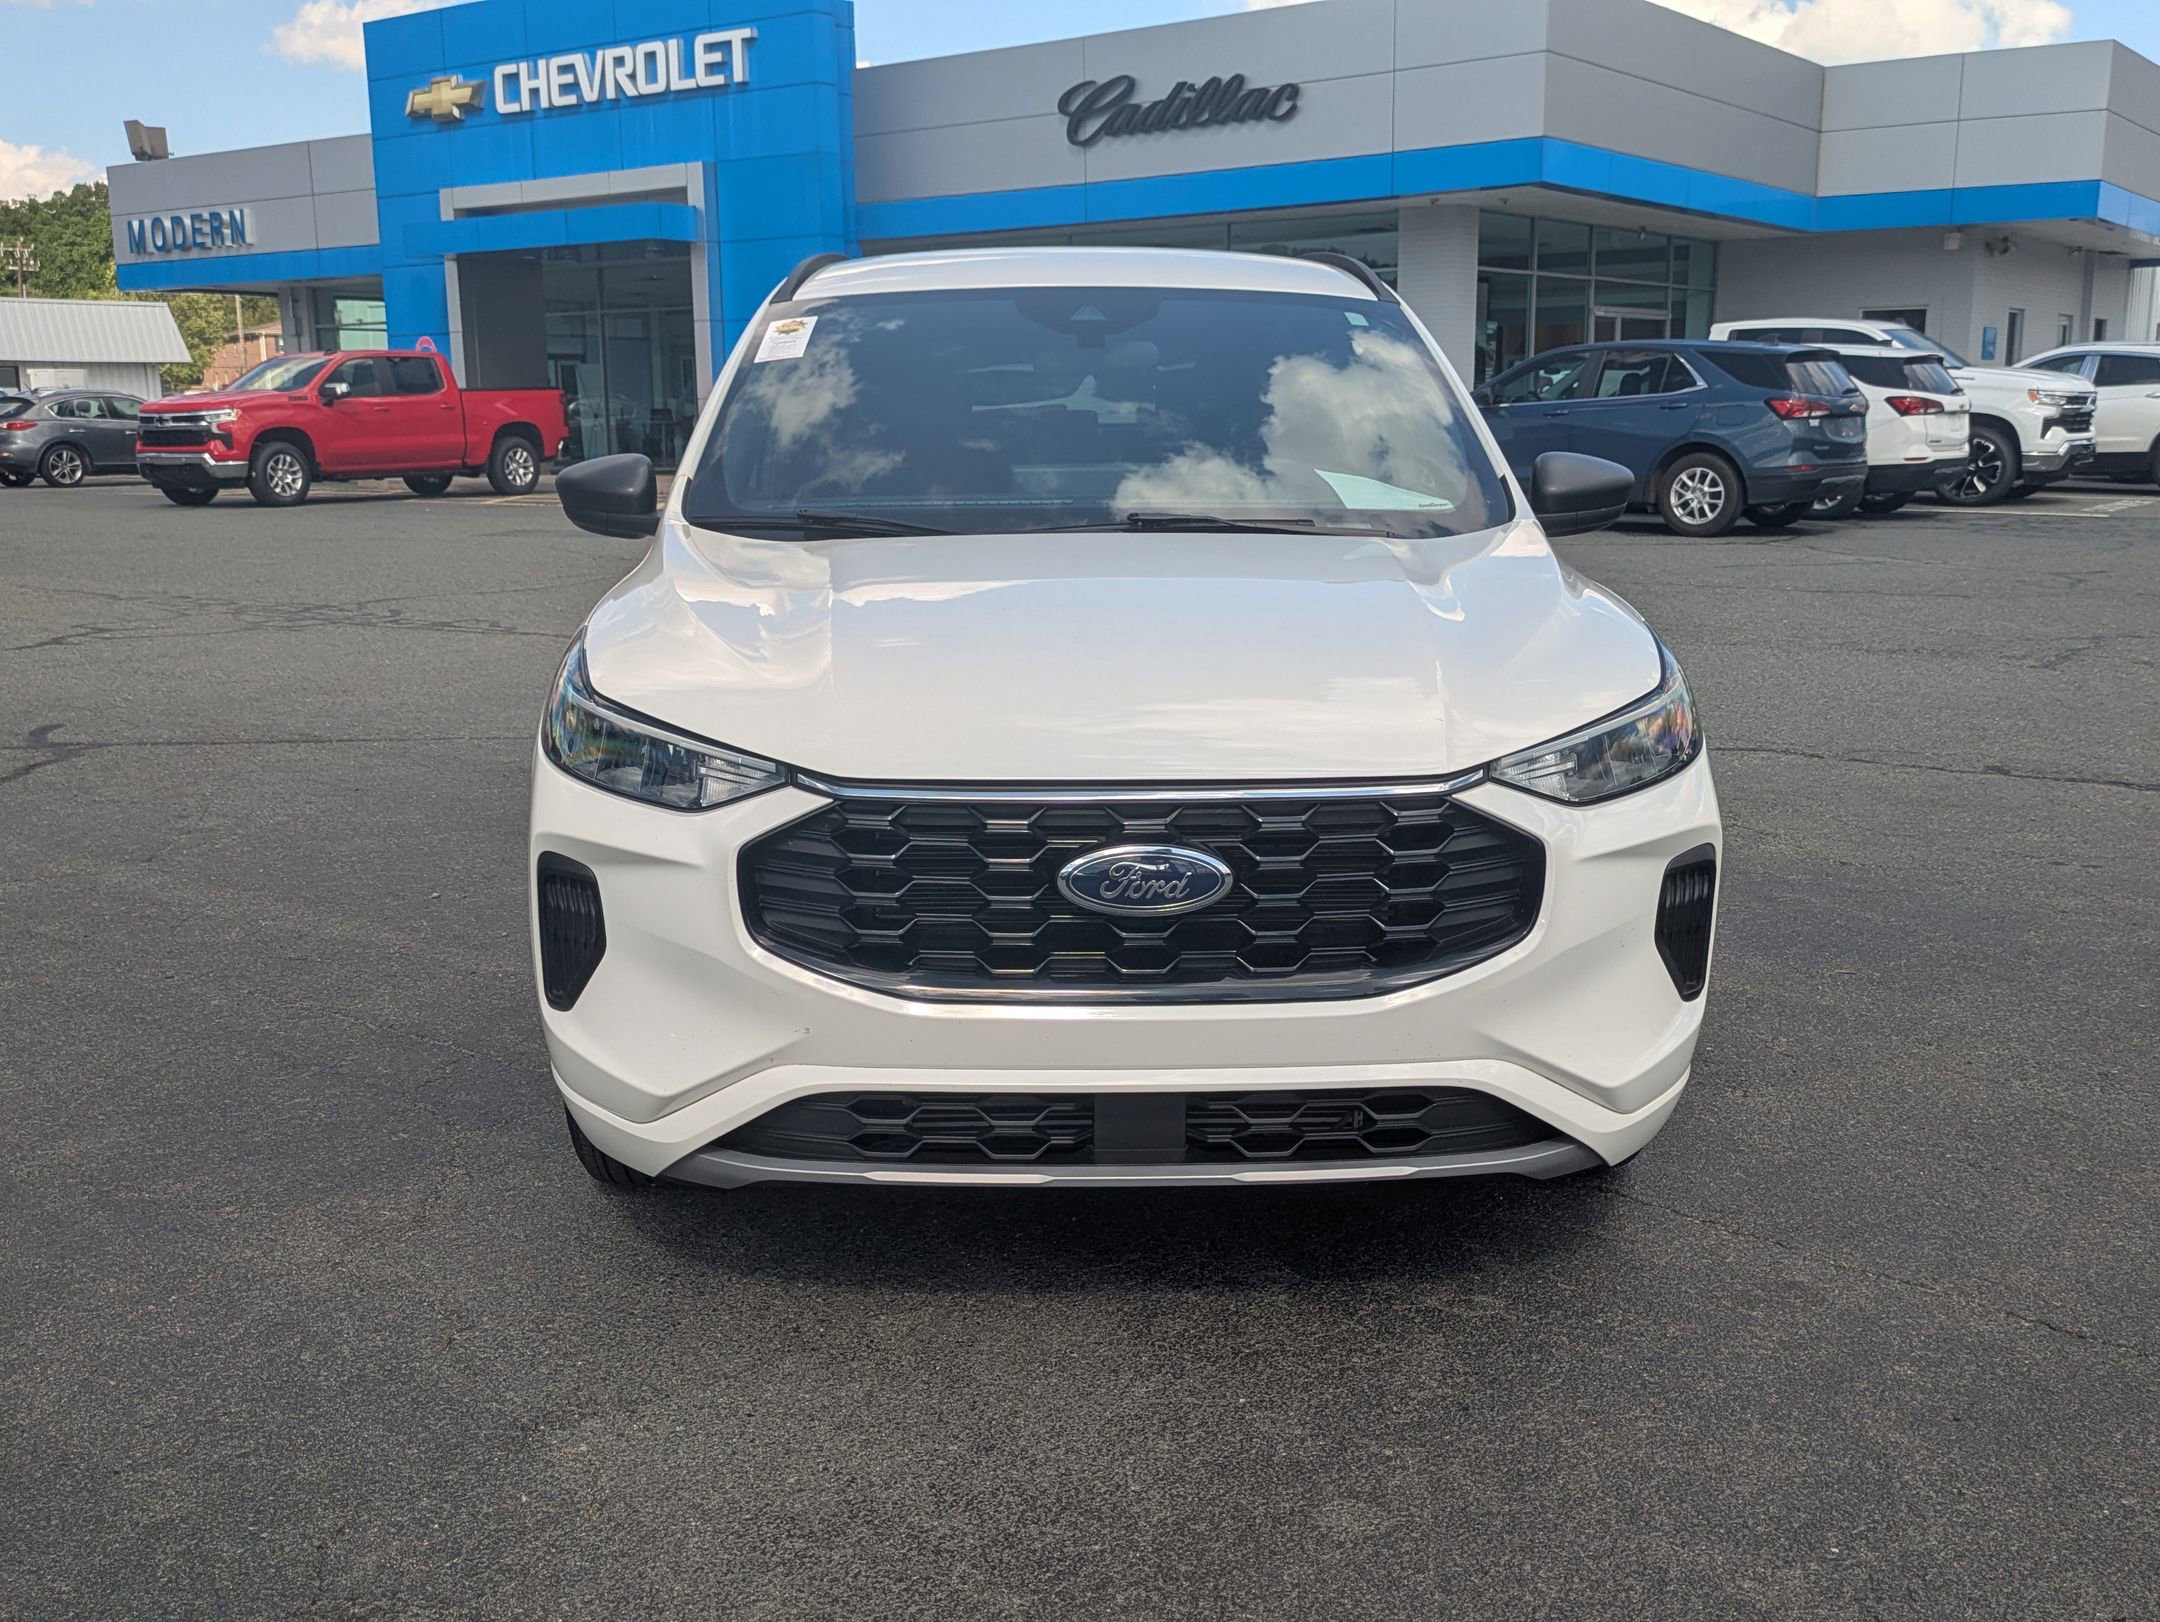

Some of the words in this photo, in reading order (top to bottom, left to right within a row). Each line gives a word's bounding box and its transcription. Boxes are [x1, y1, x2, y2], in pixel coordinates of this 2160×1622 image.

[494, 27, 757, 114] CHEVROLET
[1057, 73, 1300, 147] Cadillac
[127, 209, 248, 254] MODERN
[1100, 861, 1192, 899] Ford
